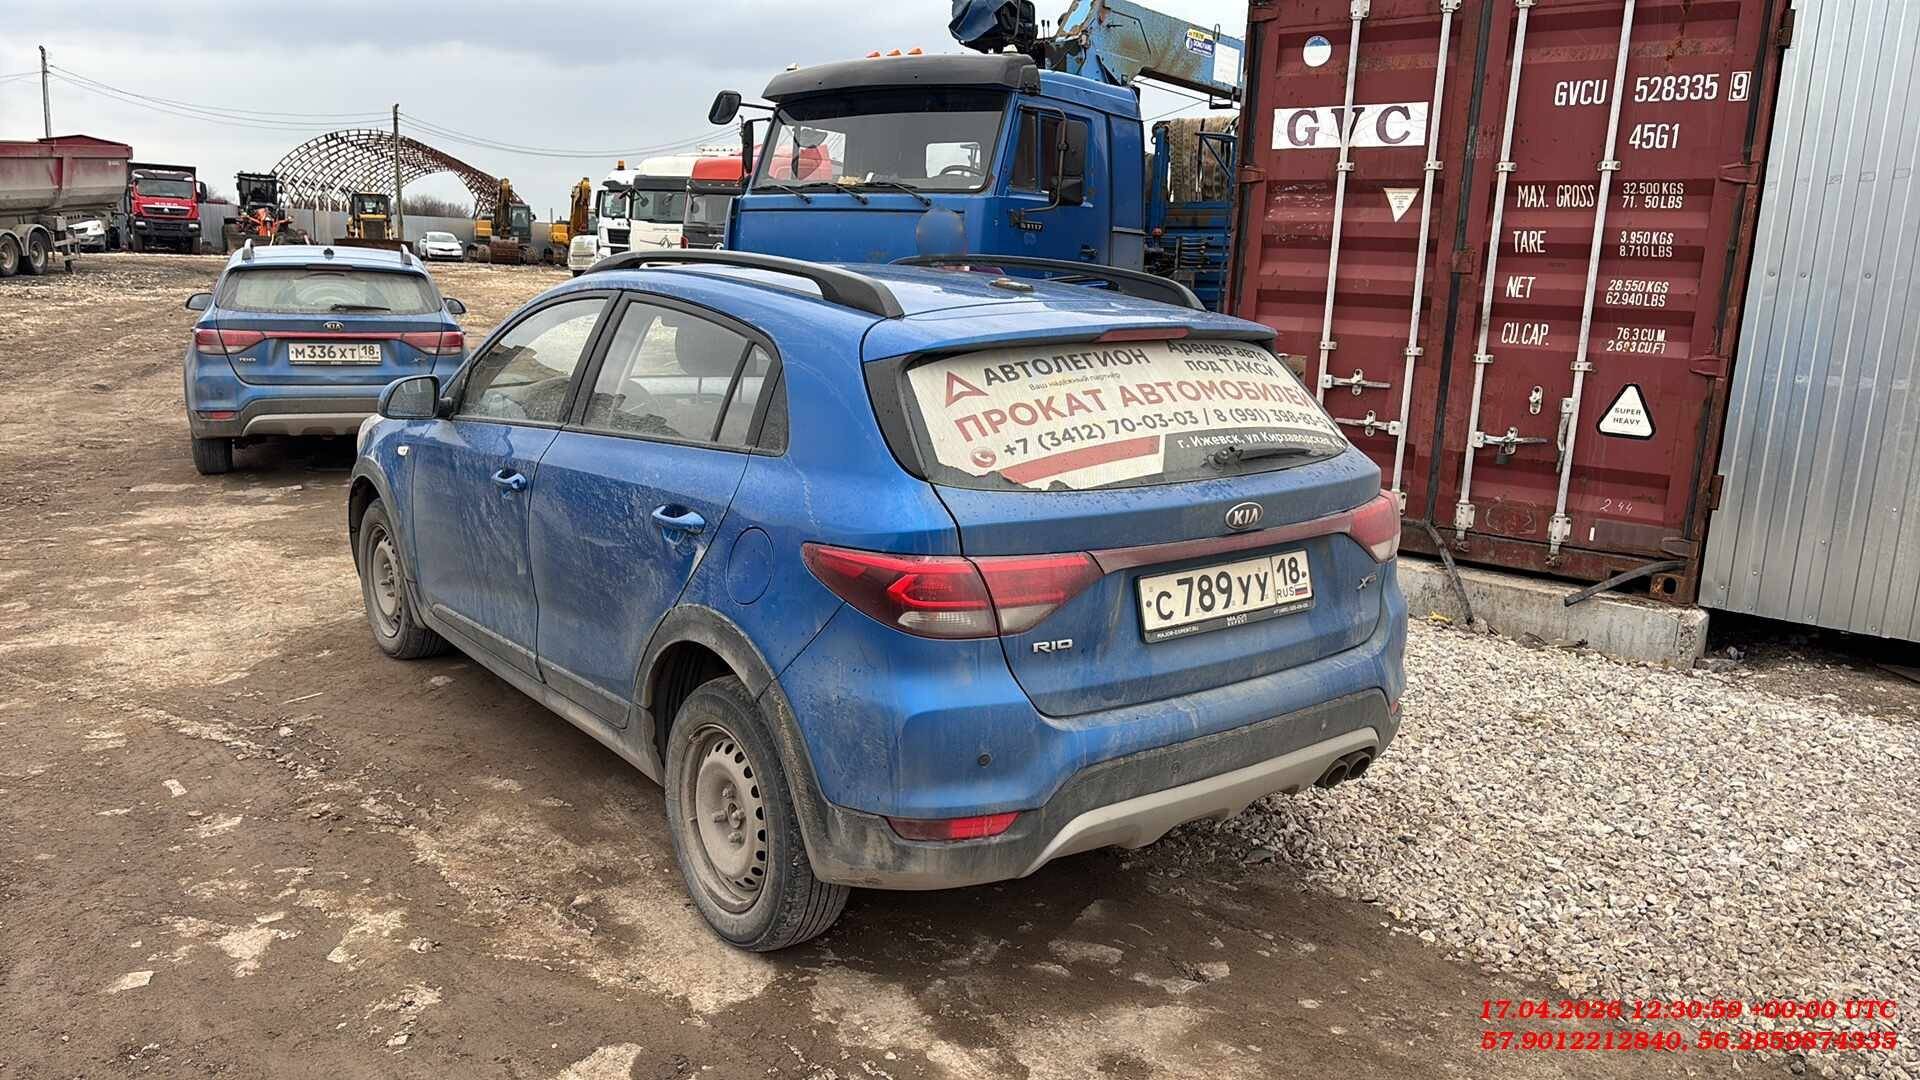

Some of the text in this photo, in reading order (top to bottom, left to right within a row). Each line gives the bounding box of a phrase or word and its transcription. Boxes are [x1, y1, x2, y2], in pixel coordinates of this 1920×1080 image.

[1554, 72, 1748, 106] GVCU 528335 9
[1629, 123, 1680, 150] 45G1
[1516, 184, 1595, 208] MAX. GROSS
[1623, 182, 1684, 194] 32.500 KGS
[1660, 195, 1683, 208] LBS
[1512, 230, 1547, 253] TARE
[1620, 230, 1674, 245] 3.950 KGS
[1619, 245, 1673, 257] 8.710 LBS
[1505, 275, 1536, 299] NET
[1608, 279, 1669, 293] 28.550 KGS
[1605, 292, 1666, 307] 62.940 LBS
[1501, 323, 1549, 346] CU.CAP.
[361, 345, 375, 356] 18
[1167, 342, 1268, 362] Аренда авто
[984, 348, 1151, 386] АВТОЛЕГИОН
[1184, 358, 1279, 378] под ТАКСИ
[954, 379, 1316, 443] ПРОКАТ АВТОМОБИЛЕЙ
[1614, 407, 1641, 416] SUPER
[1613, 417, 1641, 425] HEAVY
[1004, 438, 1029, 456] +7
[1038, 423, 1106, 451] (3412)
[1107, 410, 1199, 435] 70-03-03
[1214, 408, 1228, 423] 8
[1229, 407, 1271, 425] (991)
[1177, 438, 1188, 449] г.
[1233, 507, 1259, 525] KIA
[1276, 556, 1301, 586] 18
[1276, 586, 1295, 599] RUS
[1033, 639, 1073, 653] RIO
